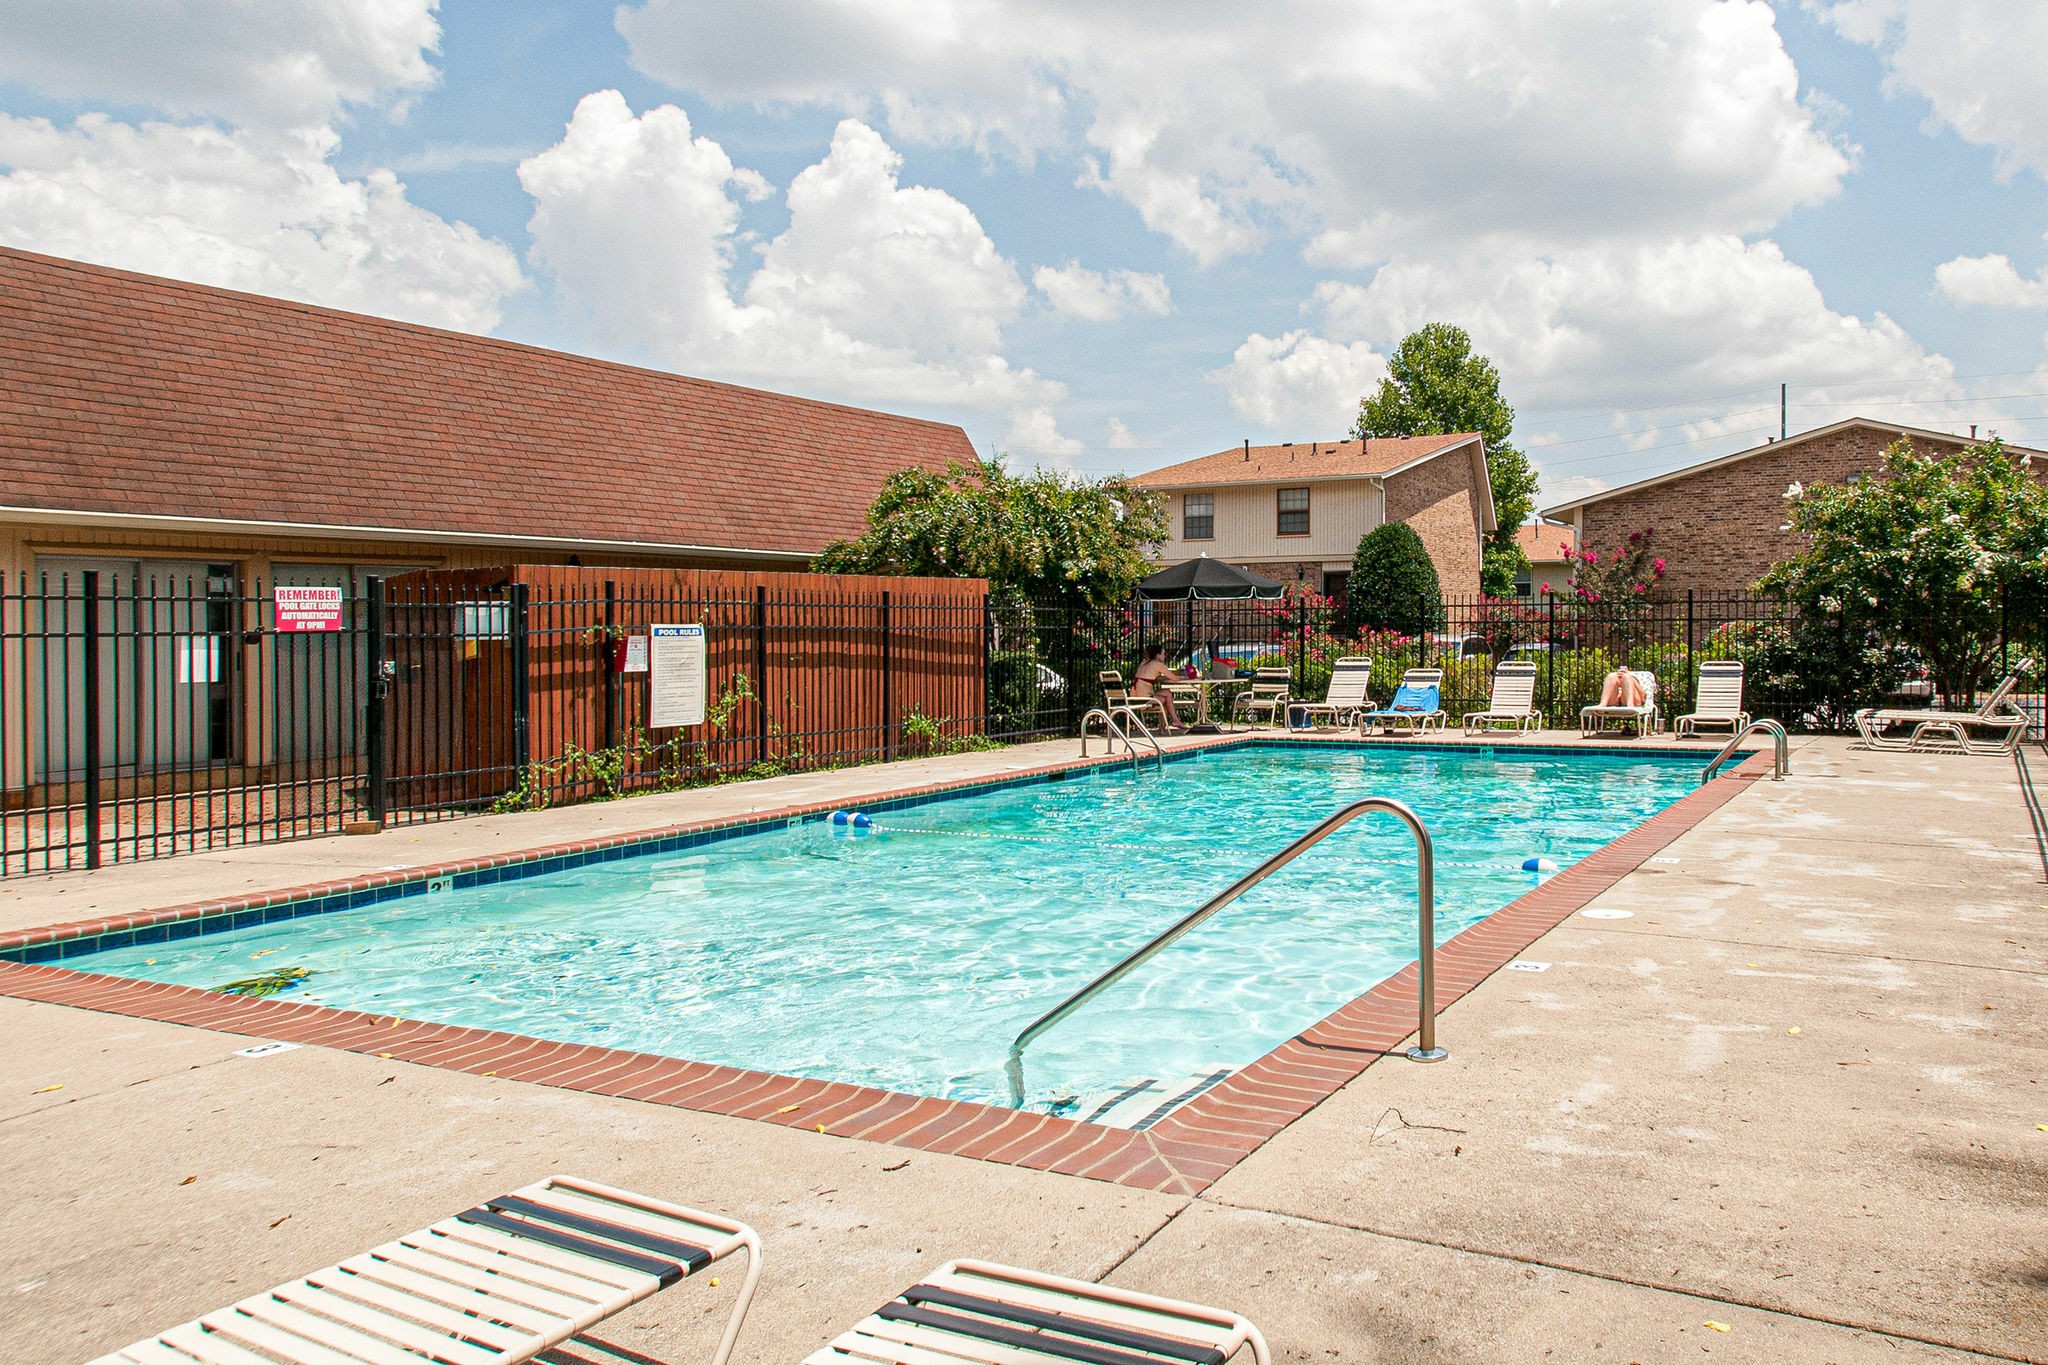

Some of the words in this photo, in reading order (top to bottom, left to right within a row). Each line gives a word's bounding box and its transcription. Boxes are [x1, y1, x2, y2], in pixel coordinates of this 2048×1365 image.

[278, 589, 341, 601] REMEMBER!
[279, 602, 299, 610] POOL
[299, 602, 318, 610] GATE
[318, 602, 341, 610] LOCKS
[281, 611, 338, 620] AUTOMATICALLY
[296, 621, 306, 629] AT
